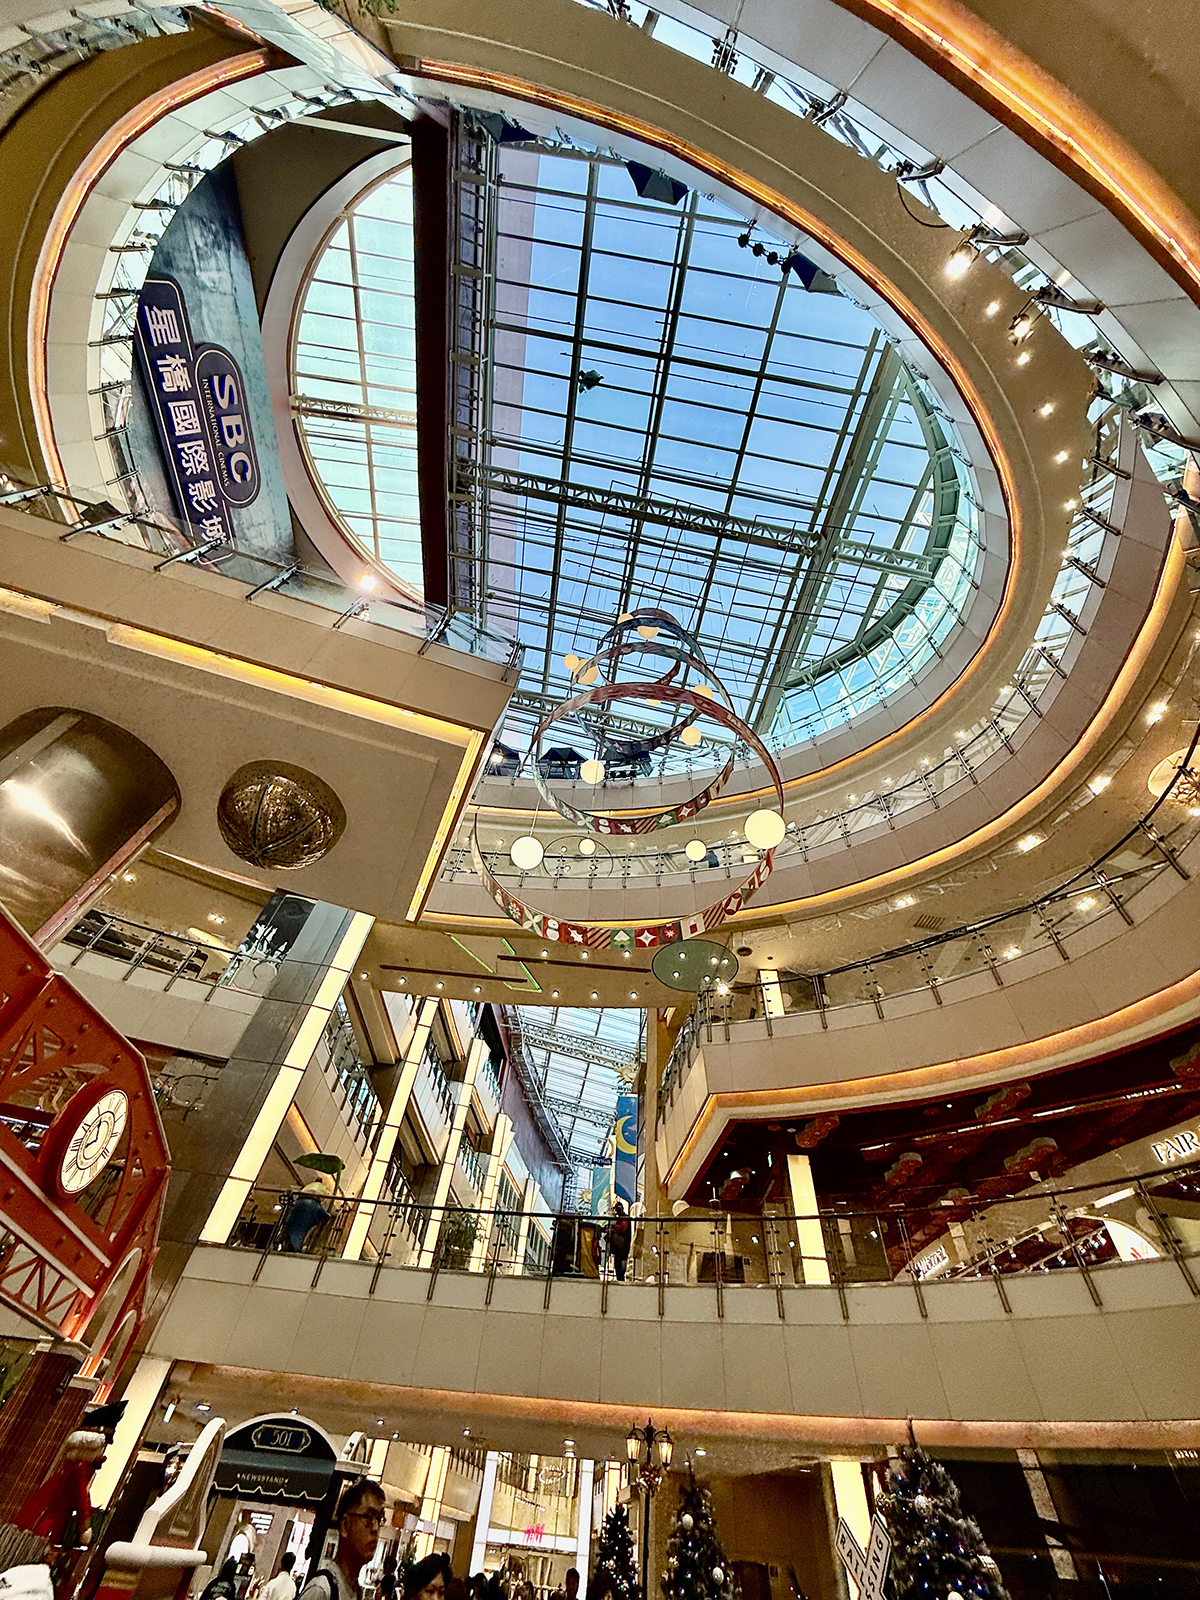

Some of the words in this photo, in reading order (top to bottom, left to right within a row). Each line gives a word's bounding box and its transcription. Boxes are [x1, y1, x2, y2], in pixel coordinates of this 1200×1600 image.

[202, 378, 222, 449] INTERNATIONAL
[217, 451, 230, 487] CINEMAS
[211, 374, 253, 484] SBC
[1151, 1127, 1200, 1164] FAIR
[270, 1430, 293, 1447] 501
[865, 1535, 883, 1600] SSING
